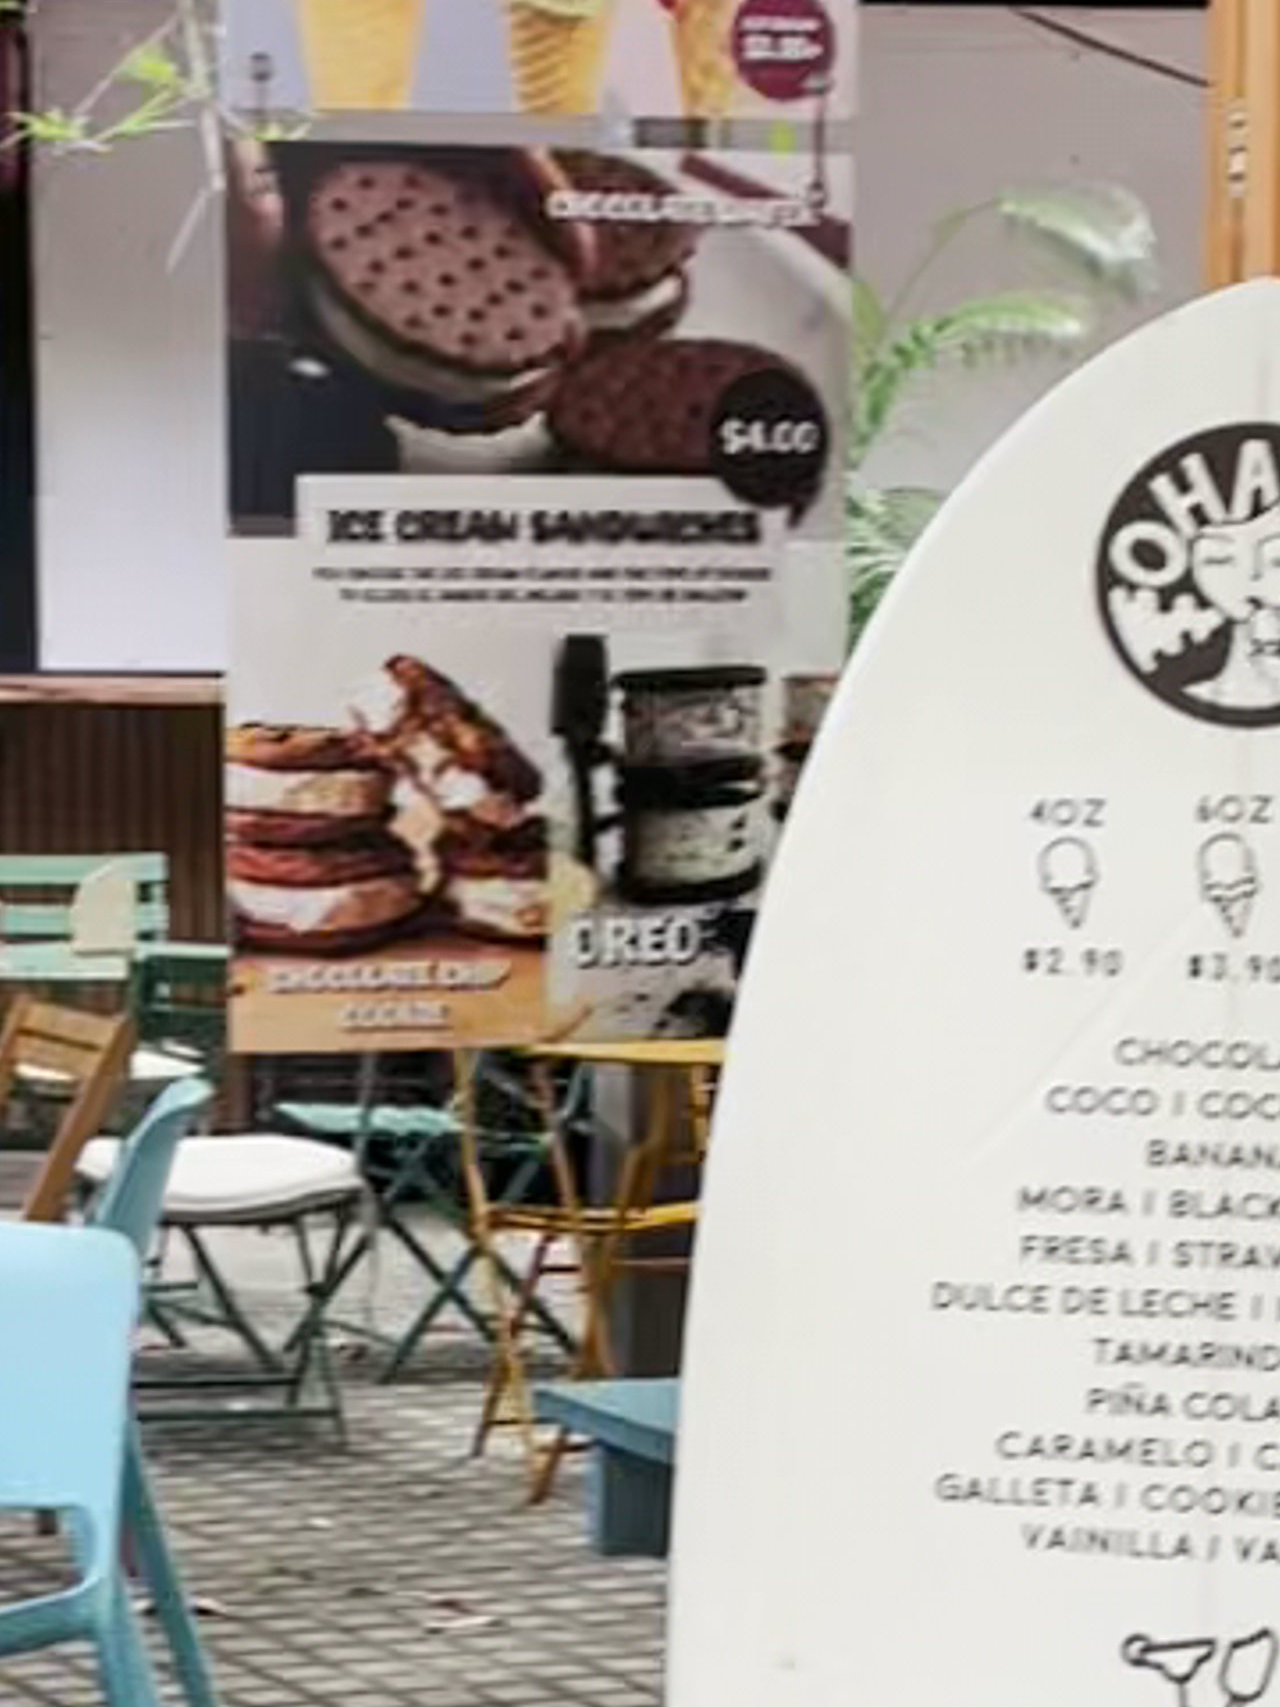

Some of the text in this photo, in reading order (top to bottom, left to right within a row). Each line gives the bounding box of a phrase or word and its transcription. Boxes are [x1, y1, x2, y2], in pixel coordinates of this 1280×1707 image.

[720, 419, 818, 454] $4.00
[326, 508, 762, 545] ICE CREAM SANDWICHES
[1029, 798, 1107, 828] 4OZ
[1194, 795, 1275, 825] 6OZ
[570, 916, 701, 967] OREO
[1045, 1085, 1160, 1117] COCO
[1017, 1185, 1125, 1216] MORA
[1020, 1233, 1134, 1266] FRESA
[931, 1280, 1051, 1314] DULCE
[1060, 1284, 1109, 1315] DE
[1120, 1286, 1237, 1321] LECHE
[1084, 1381, 1171, 1418] PIÑA
[994, 1429, 1216, 1469] CARAMELO
[933, 1472, 1101, 1509] GALLETA
[1020, 1522, 1193, 1561] VAINILLA
